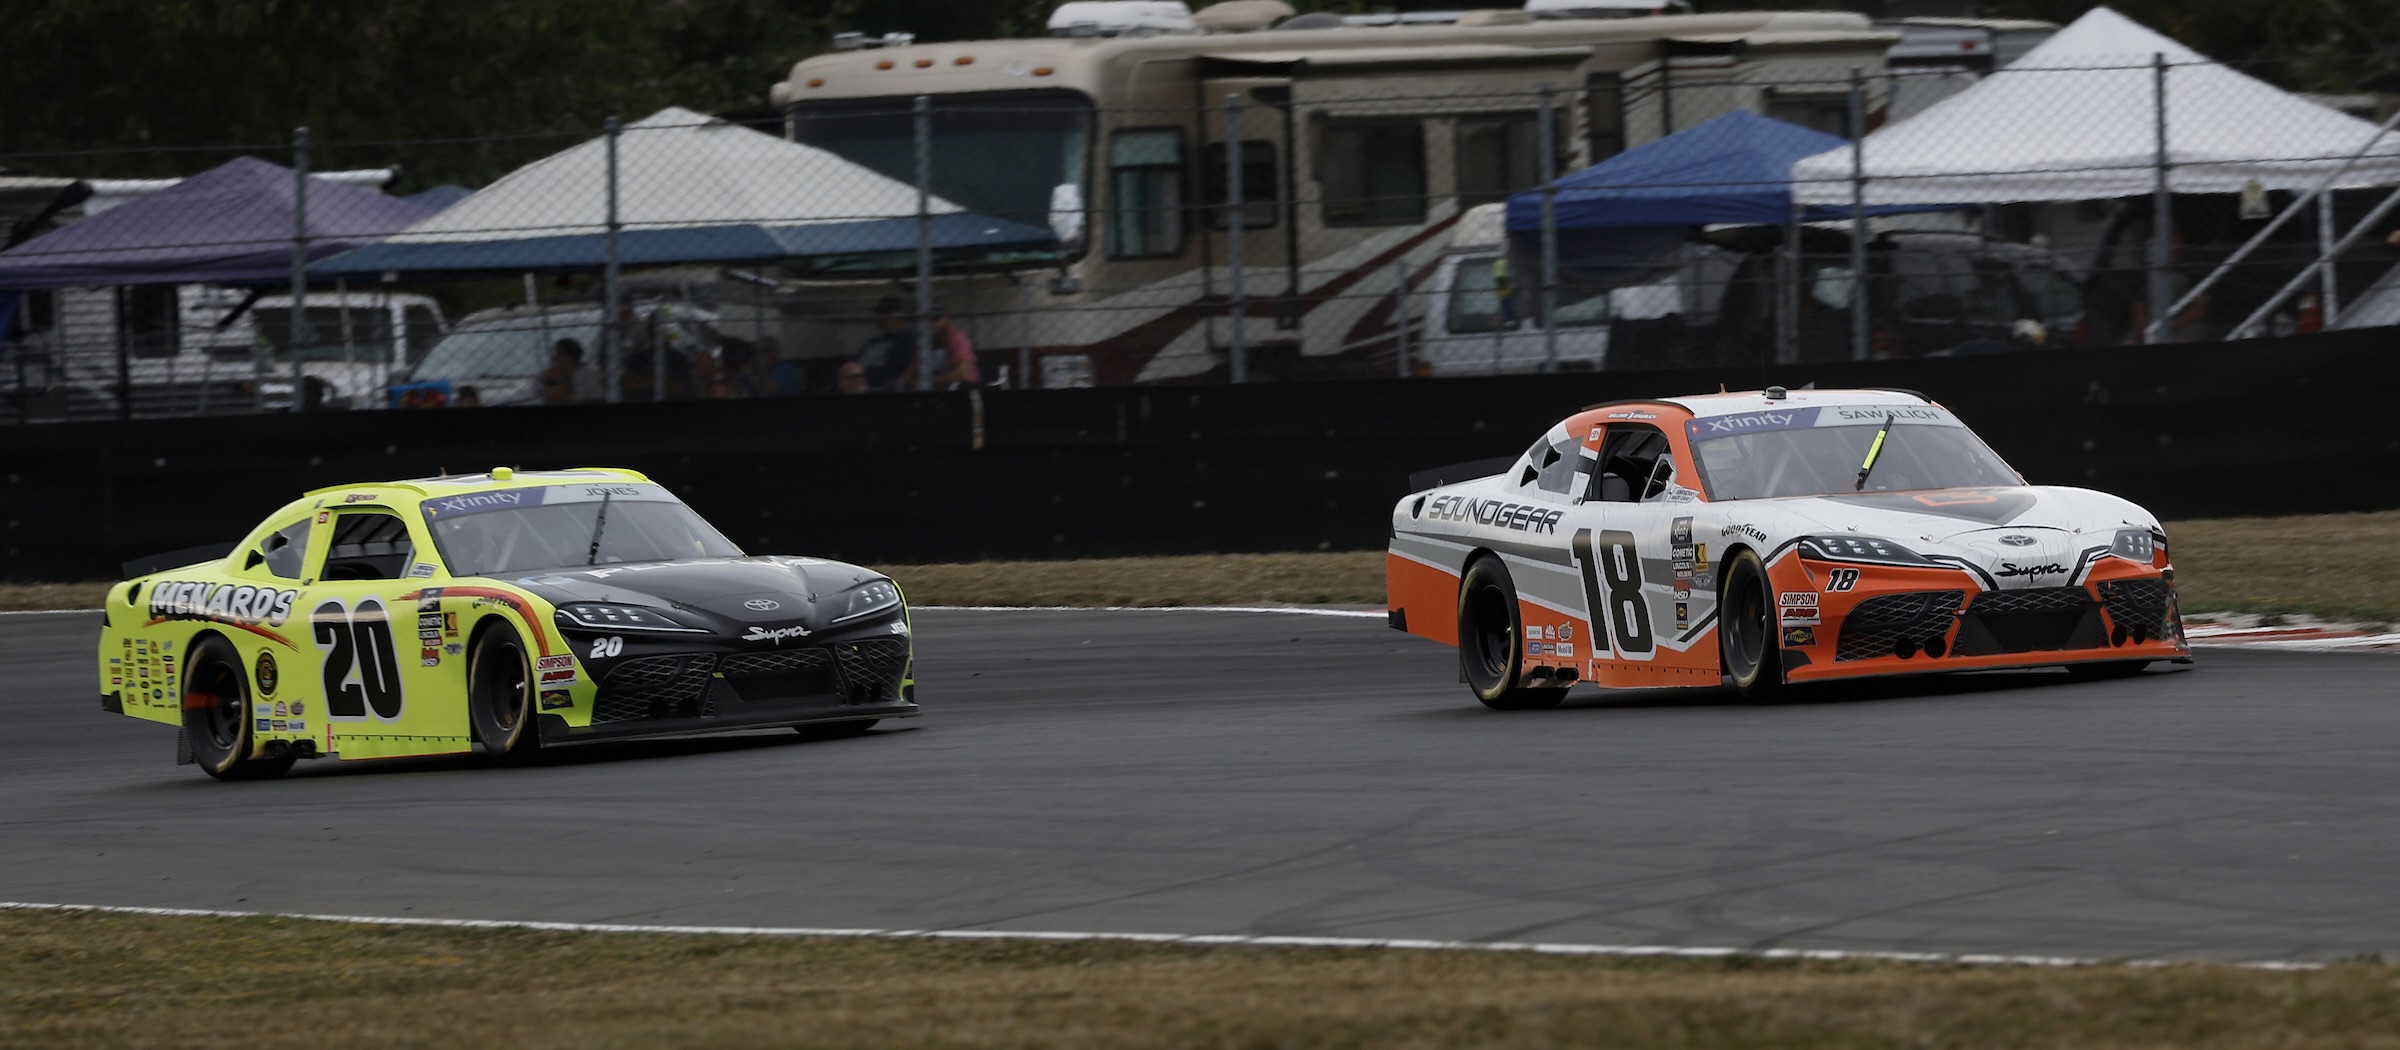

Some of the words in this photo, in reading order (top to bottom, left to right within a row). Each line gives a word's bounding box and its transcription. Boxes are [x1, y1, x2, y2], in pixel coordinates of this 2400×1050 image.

[1708, 413, 1793, 432] xfinity
[1839, 409, 1940, 420] SAWALICH
[586, 486, 640, 496] JONES
[441, 491, 521, 512] xfinity
[1429, 495, 1565, 535] SOUNDGEAR
[1721, 523, 1767, 543] GOODYEAR
[1672, 547, 1693, 558] COMETIC
[1825, 568, 1860, 593] 18
[1995, 563, 2068, 583] Supra
[1572, 527, 1655, 655] 18
[1673, 590, 1690, 600] MSD
[1781, 593, 1817, 605] SIMPSON
[150, 581, 298, 626] MENARDS
[742, 626, 811, 646] Supra
[589, 636, 623, 659] 20
[311, 597, 404, 721] 20
[538, 655, 574, 669] SIMPSON
